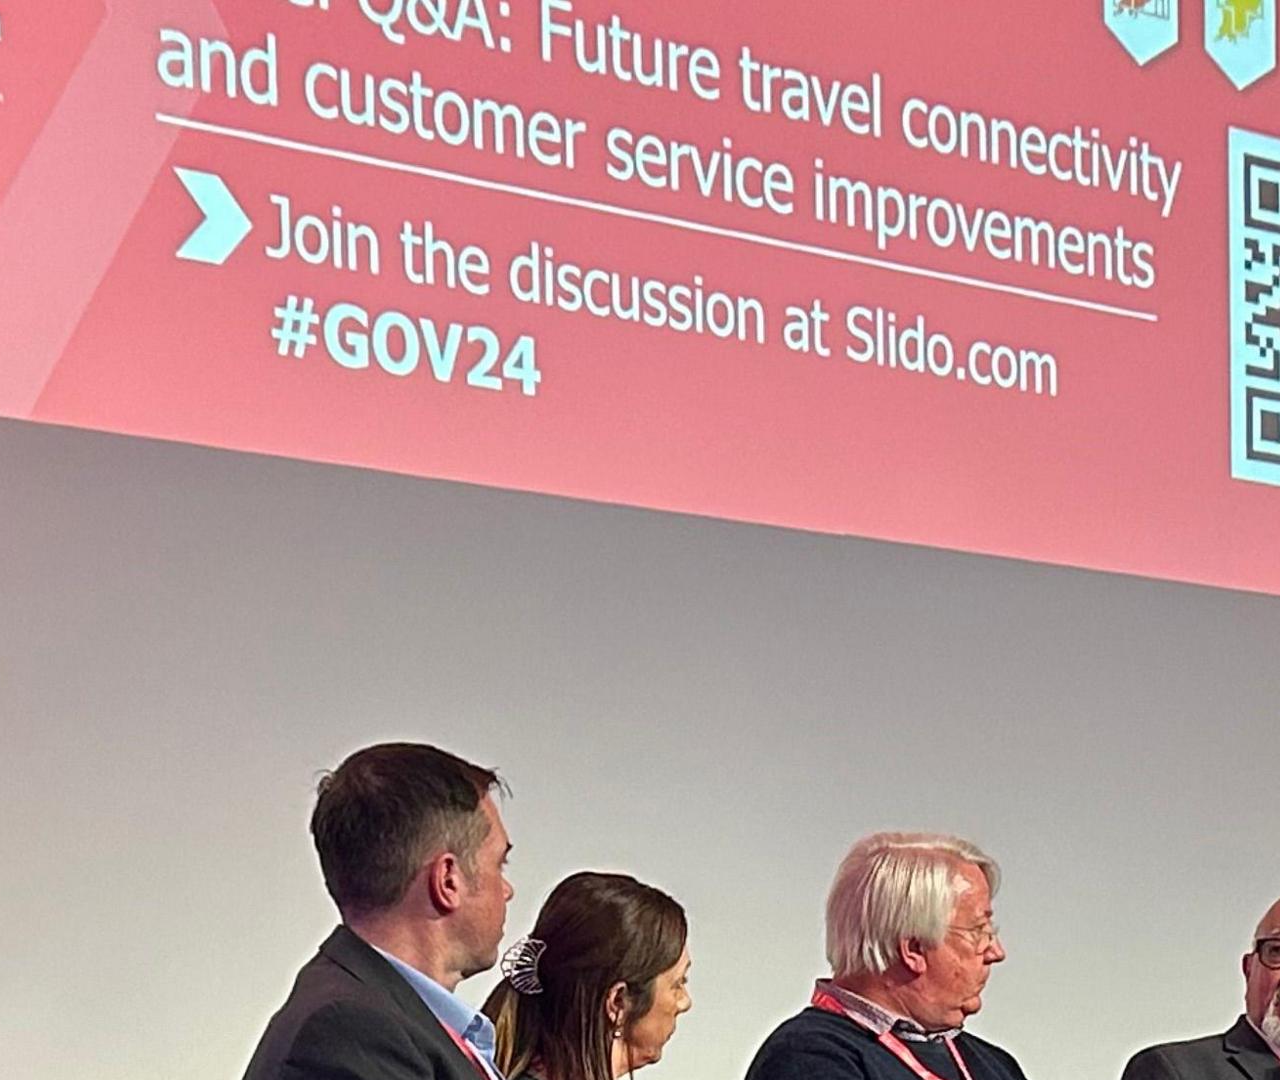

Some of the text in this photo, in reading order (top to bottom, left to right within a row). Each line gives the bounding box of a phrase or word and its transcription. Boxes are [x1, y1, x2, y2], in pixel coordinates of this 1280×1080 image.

[155, 29, 1156, 289] and customer service improvements
[539, 0, 721, 101] Future
[738, 46, 882, 138] travel
[901, 97, 1183, 218] connectivity
[265, 194, 1058, 397] Join the discussion at Slido.com
[270, 294, 542, 397] #GOV24
